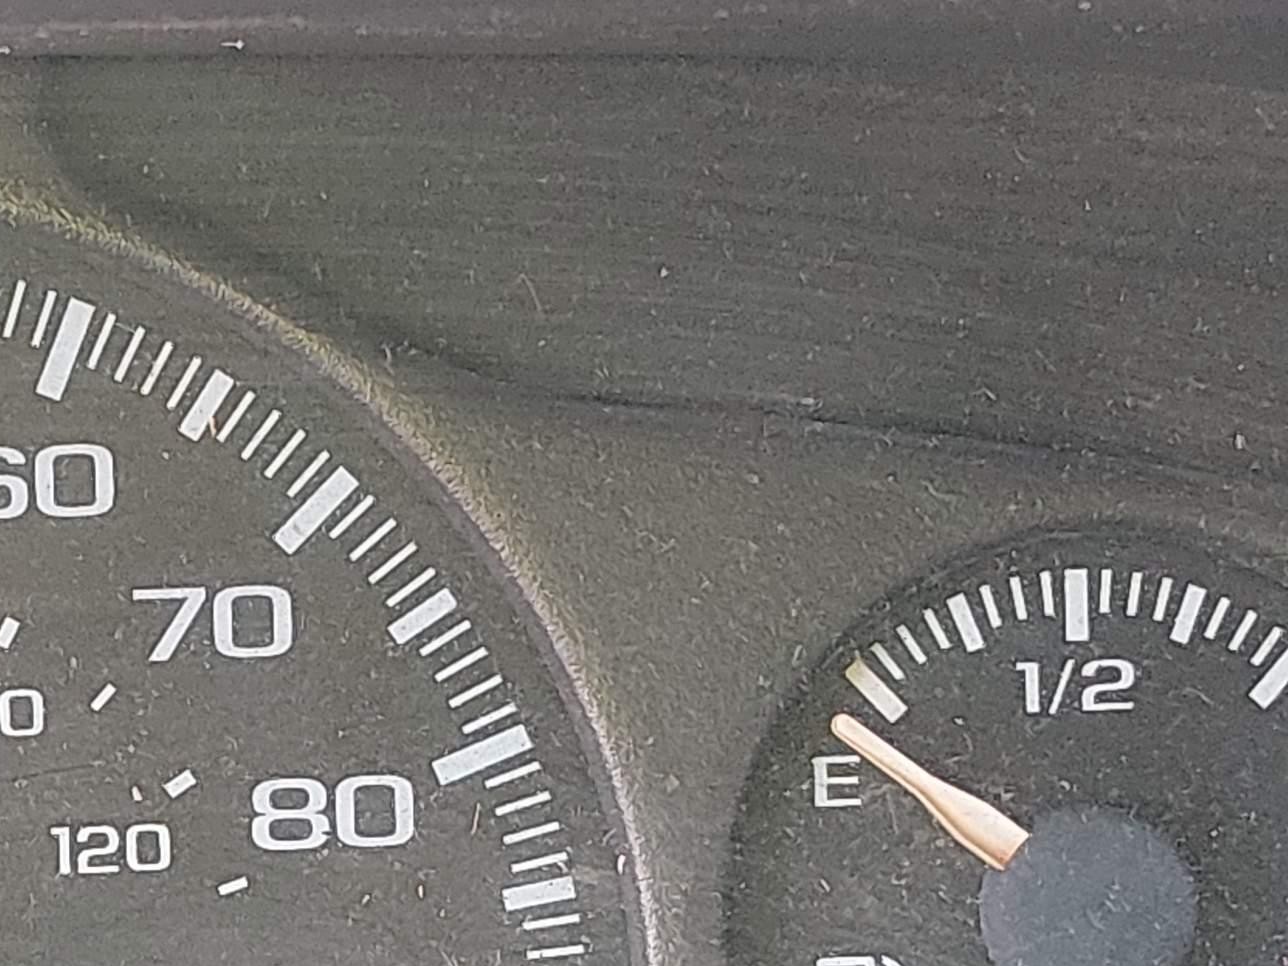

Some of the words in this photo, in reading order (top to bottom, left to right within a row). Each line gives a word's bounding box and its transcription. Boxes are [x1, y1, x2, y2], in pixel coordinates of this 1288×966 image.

[132, 585, 293, 662] 70
[1015, 659, 1135, 715] 1/2
[811, 755, 862, 807] E
[251, 774, 415, 851] 80
[50, 823, 171, 875] 120
